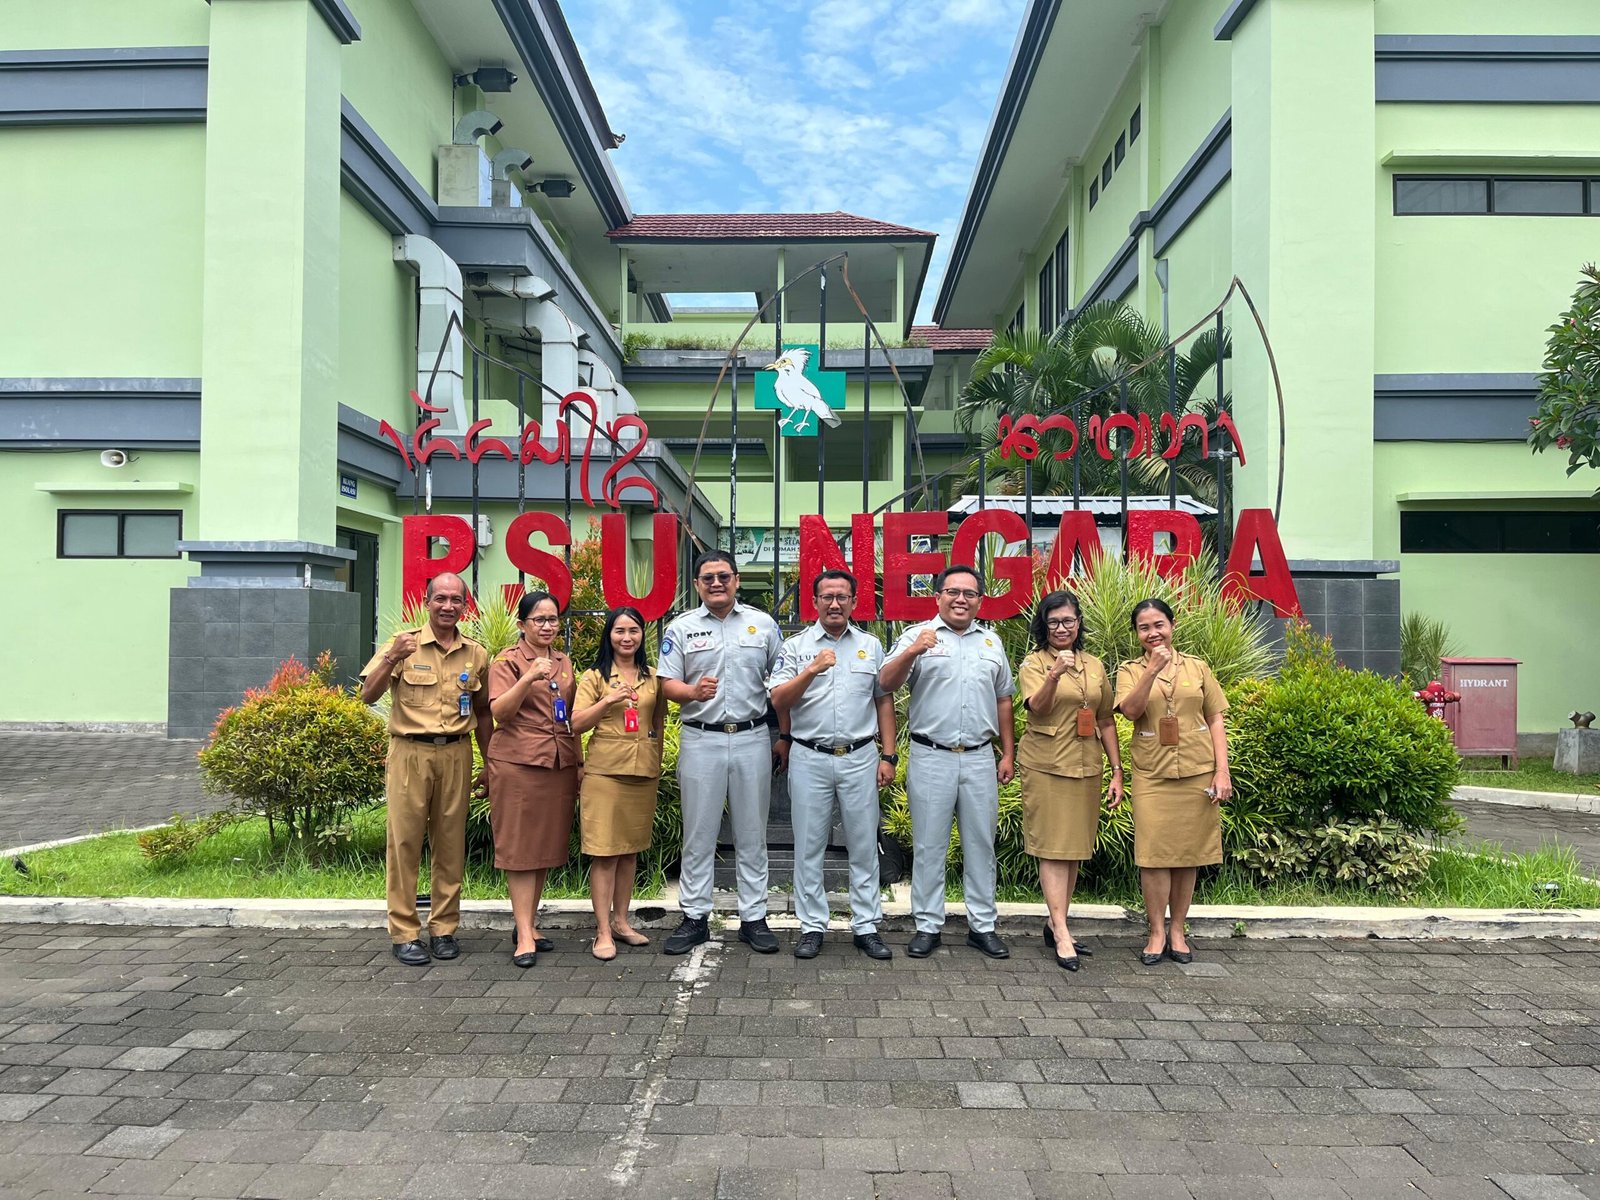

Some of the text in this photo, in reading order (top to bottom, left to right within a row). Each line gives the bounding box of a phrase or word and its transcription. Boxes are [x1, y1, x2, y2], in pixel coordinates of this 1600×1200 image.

[402, 508, 1304, 622] RSU NEGARA
[687, 630, 713, 639] ROBY
[1459, 679, 1509, 688] HYDRANT
